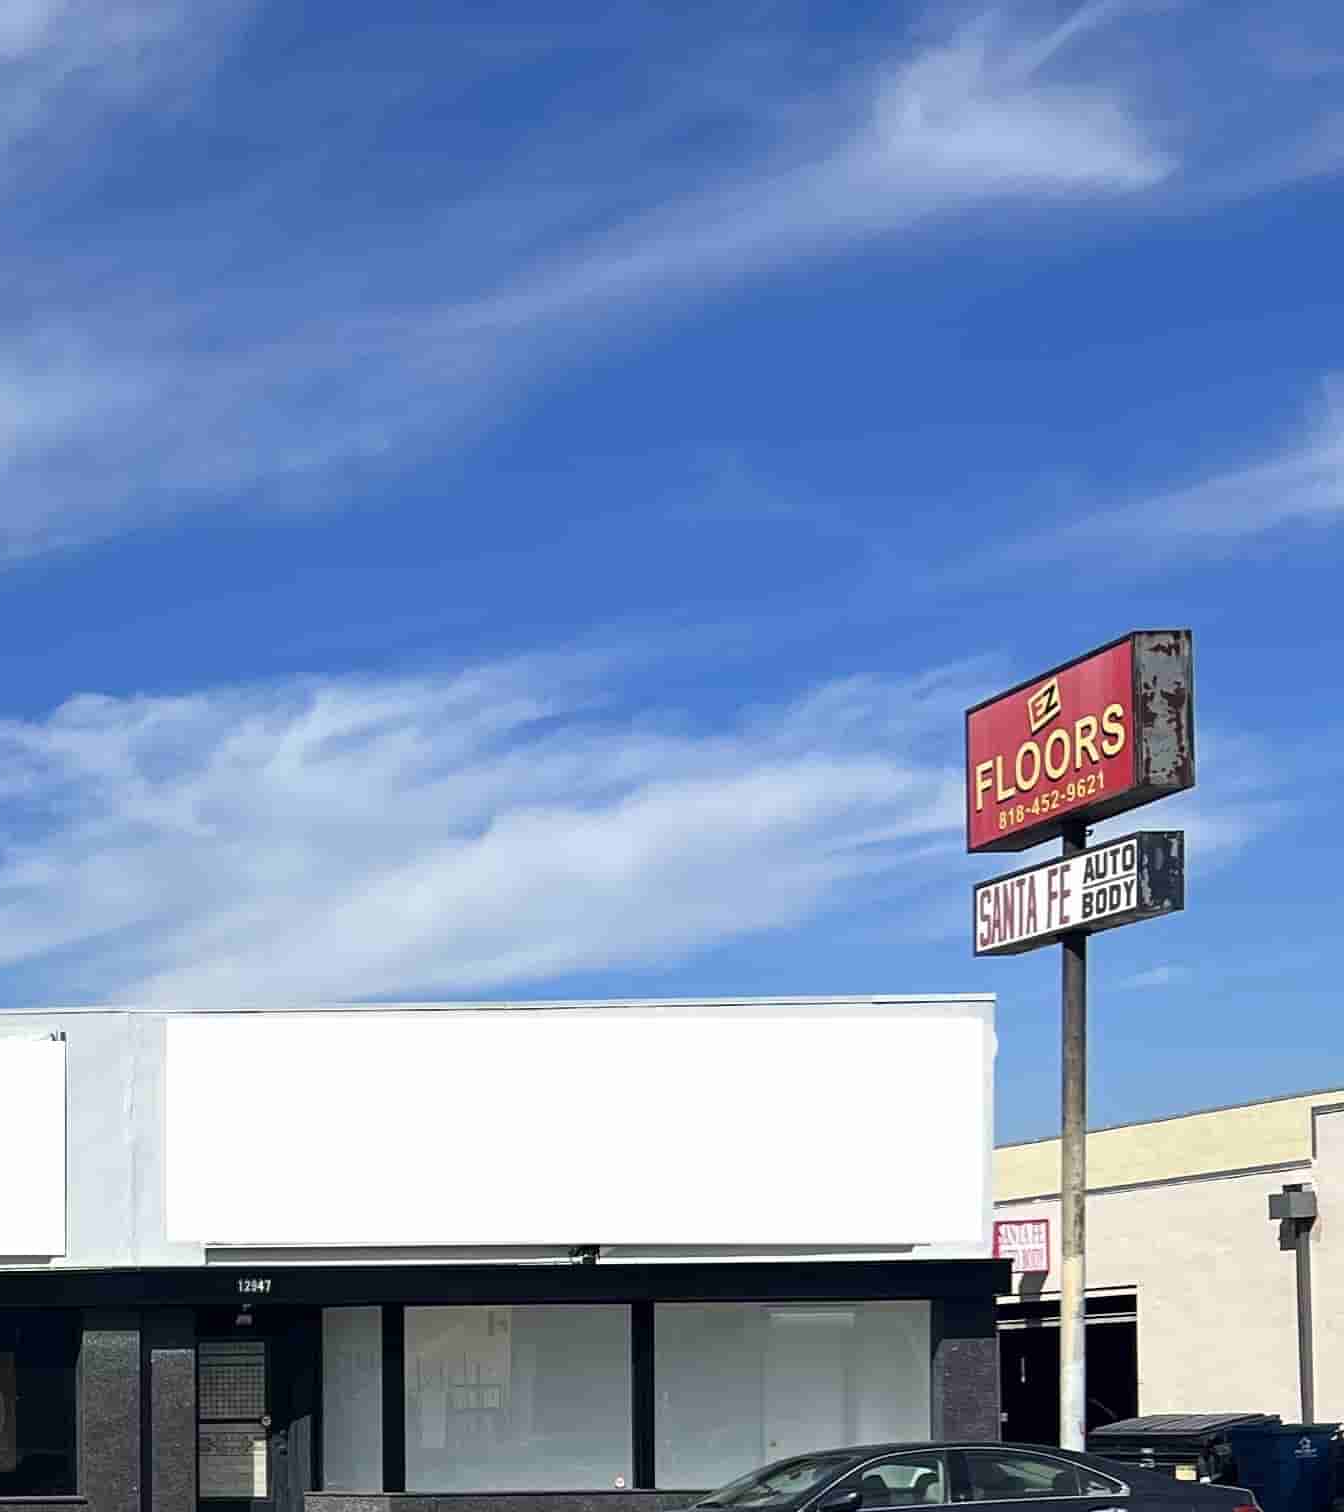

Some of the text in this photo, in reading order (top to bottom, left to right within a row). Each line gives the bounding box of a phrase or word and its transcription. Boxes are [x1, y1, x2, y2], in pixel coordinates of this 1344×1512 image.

[975, 703, 1127, 814] FLOORS
[998, 771, 1106, 831] 818-452-9621
[1083, 843, 1136, 884] AUTO
[979, 864, 1073, 948] SANTA FE
[1081, 879, 1136, 919] BODY
